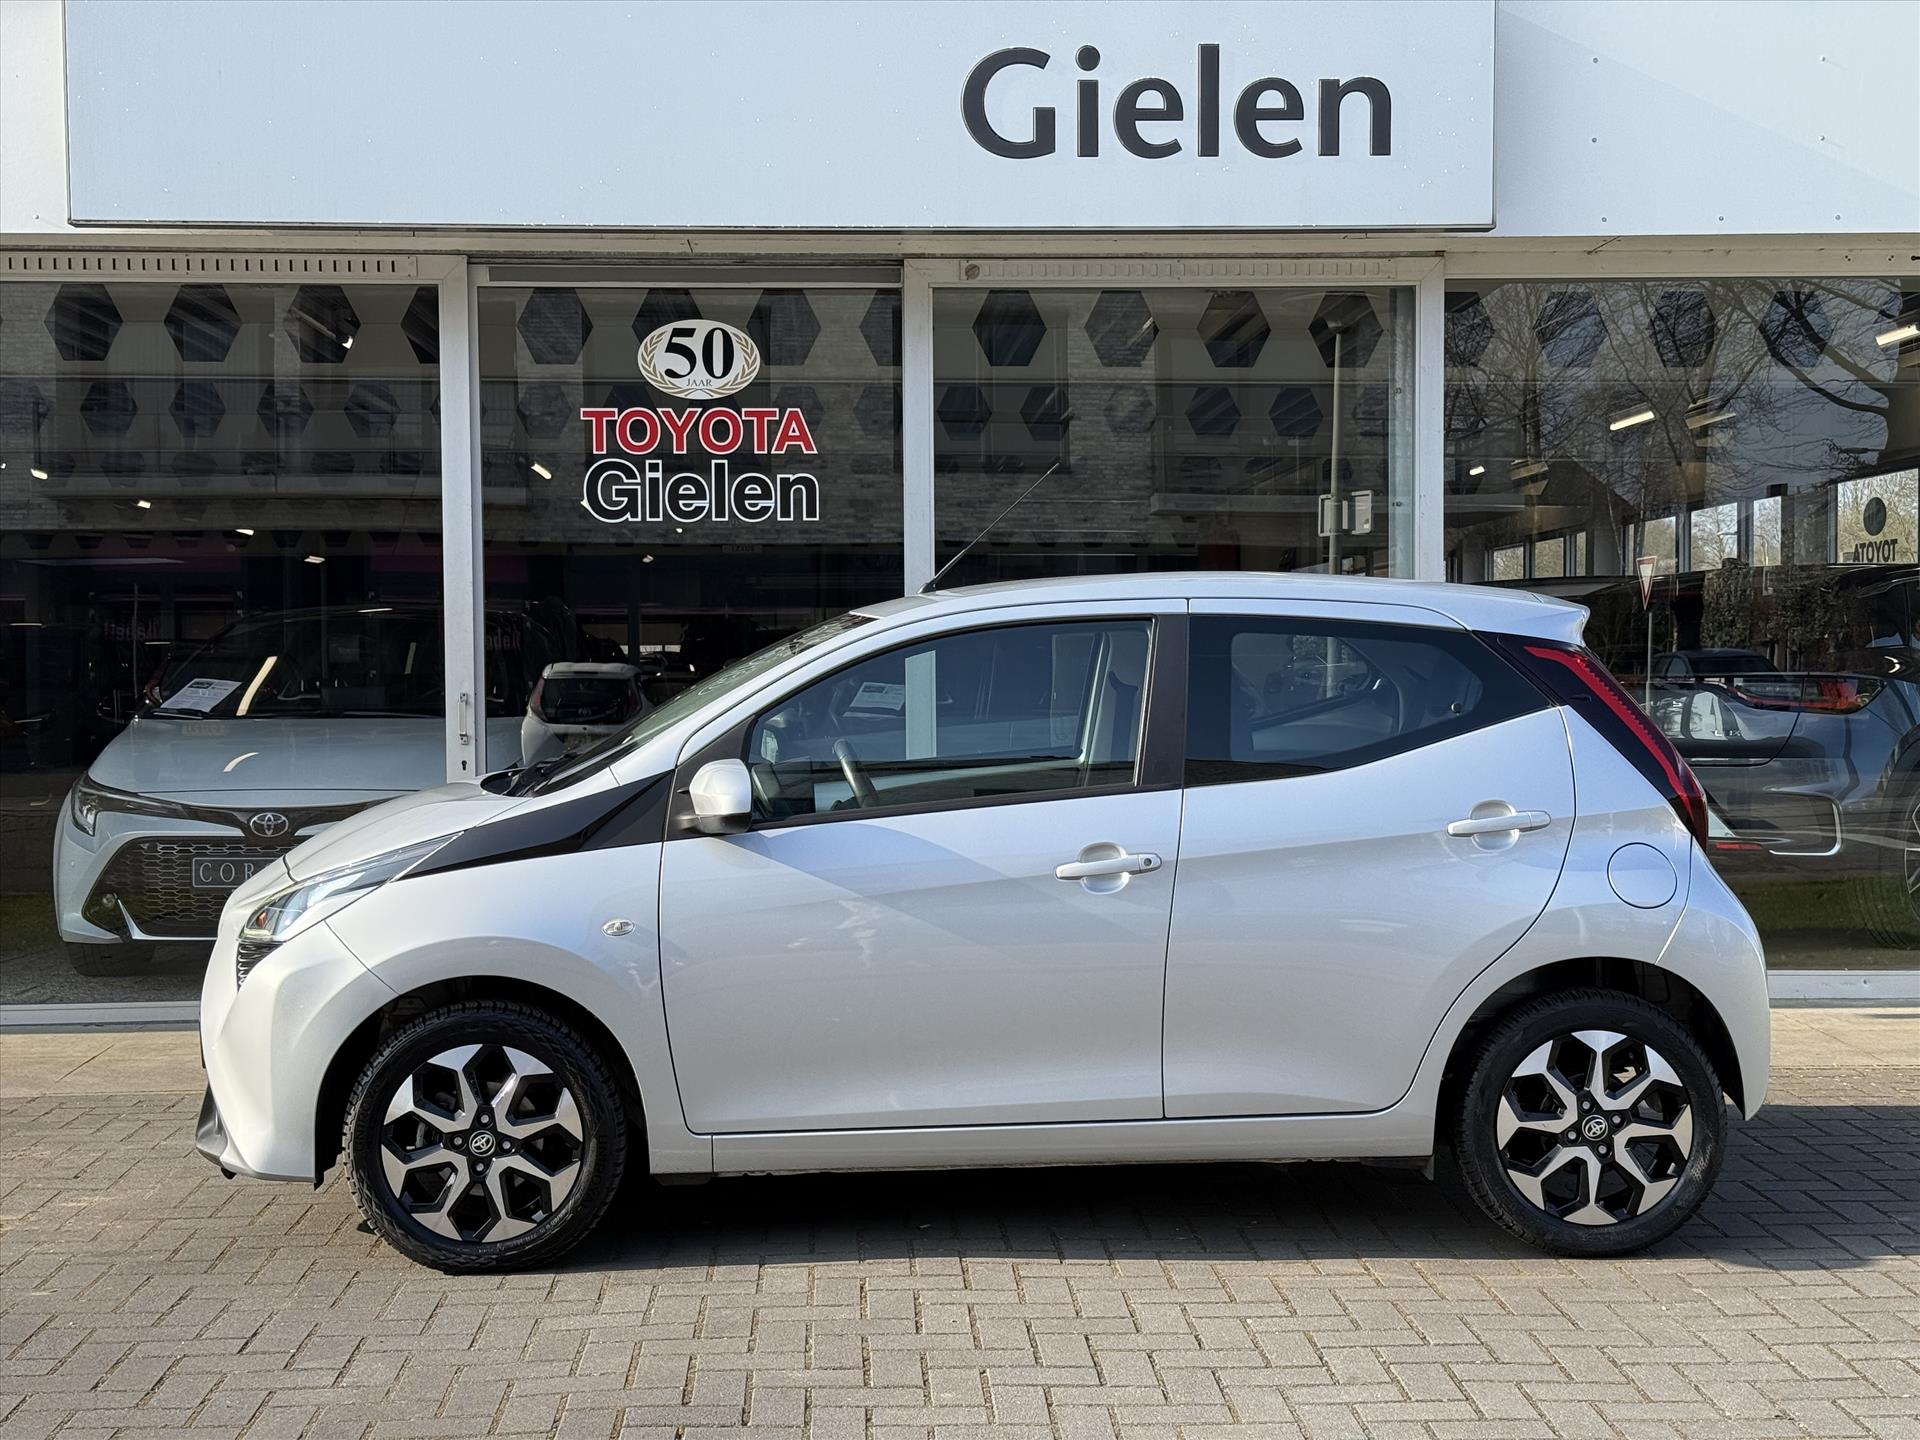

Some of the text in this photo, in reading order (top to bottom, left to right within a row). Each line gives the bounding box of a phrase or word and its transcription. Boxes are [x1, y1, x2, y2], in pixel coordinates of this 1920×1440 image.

[960, 43, 1392, 160] Gielen
[664, 327, 735, 379] 50
[686, 379, 713, 388] JAAR
[580, 407, 818, 455] TOYOTA
[584, 458, 820, 523] Gielen
[199, 862, 272, 883] COR
